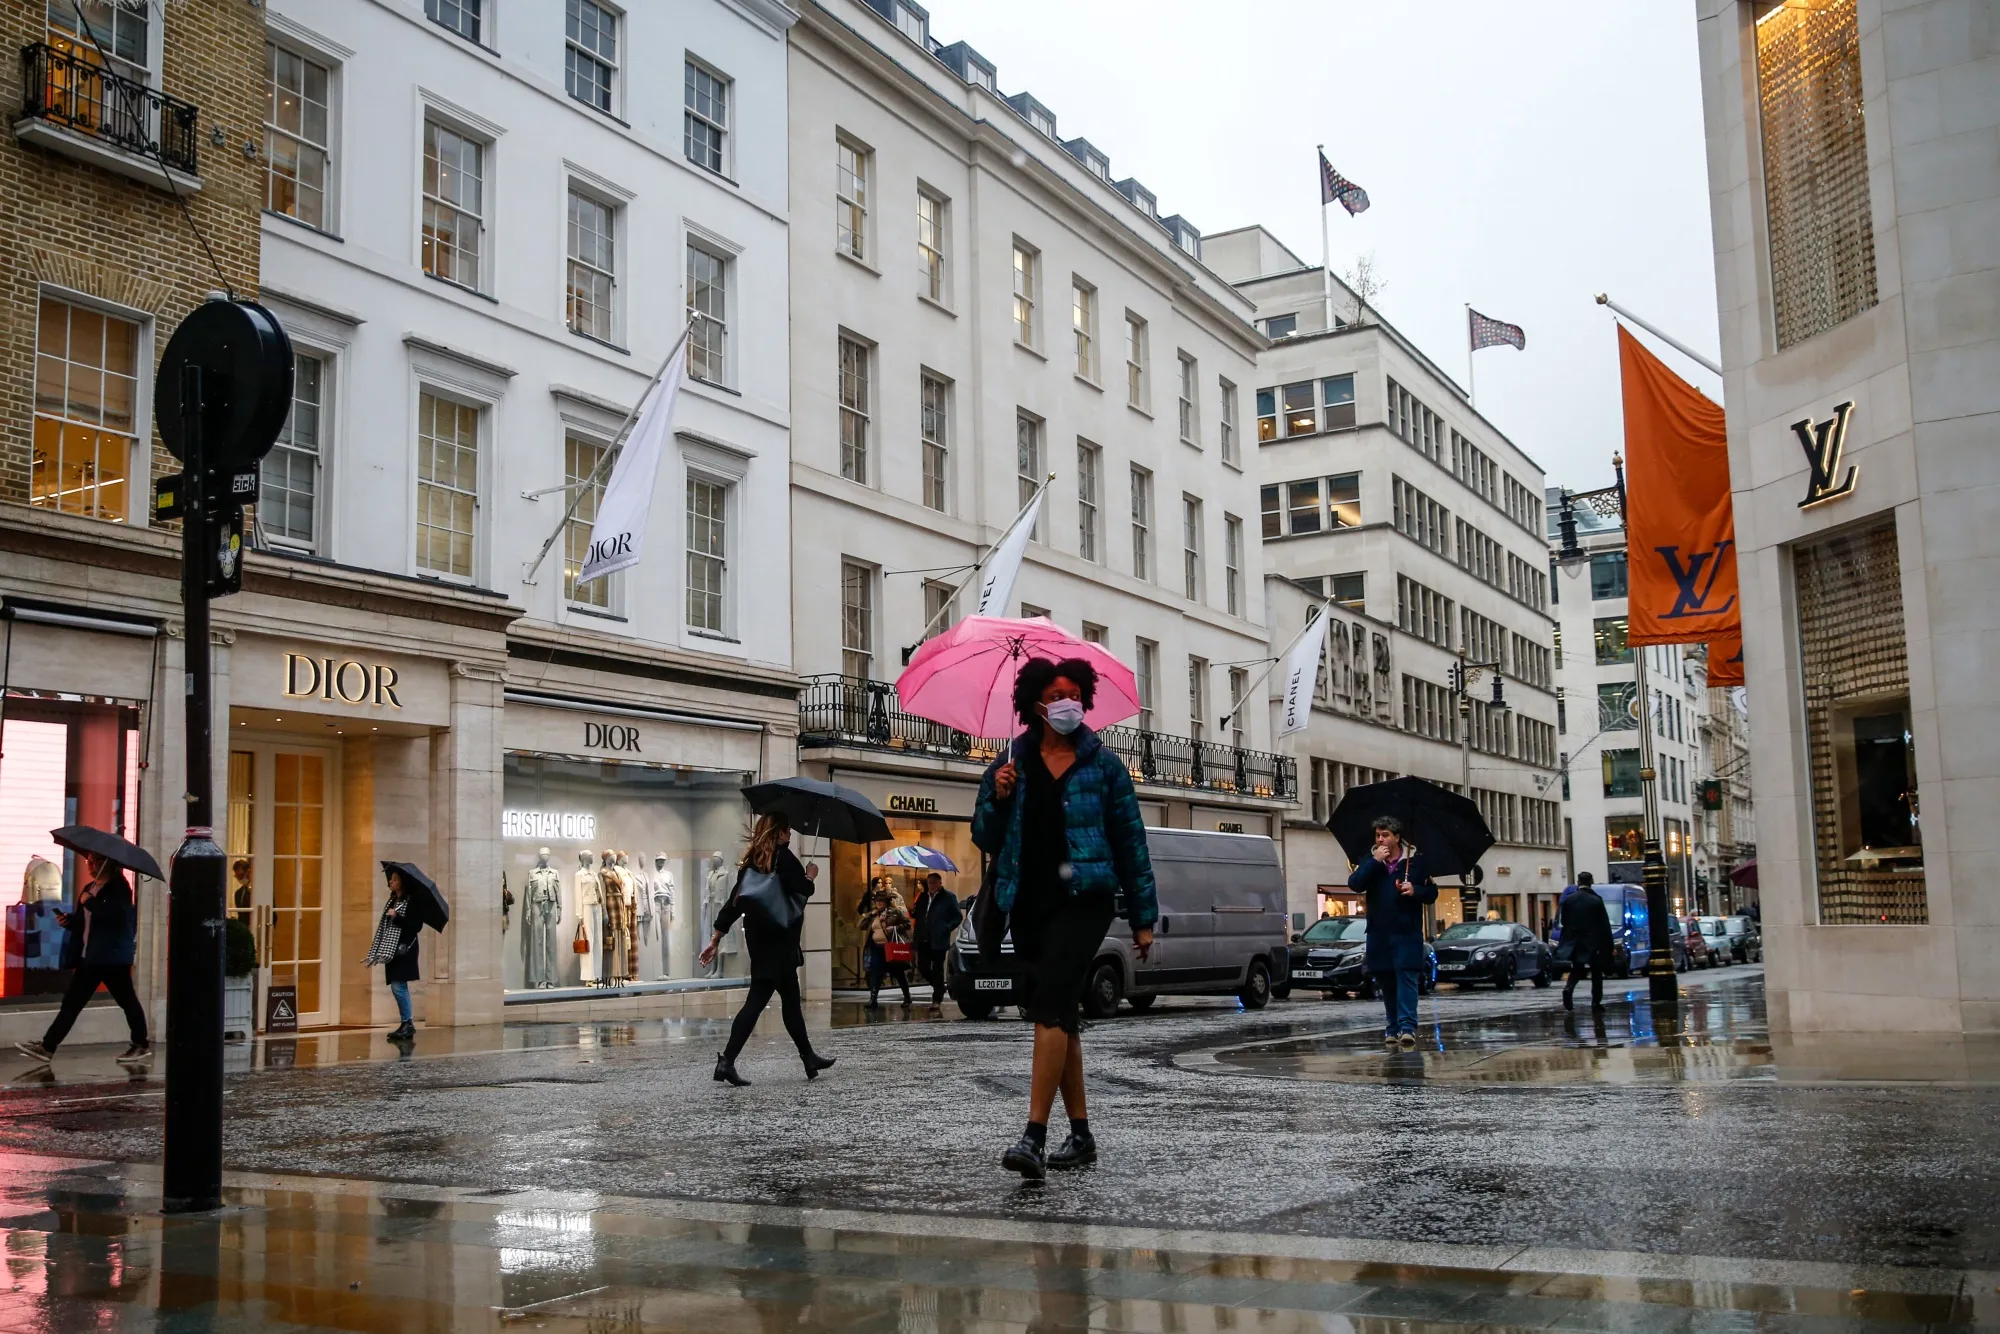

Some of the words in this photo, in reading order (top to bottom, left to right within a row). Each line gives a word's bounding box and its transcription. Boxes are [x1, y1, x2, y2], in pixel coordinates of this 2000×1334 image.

[233, 475, 256, 491] sick
[283, 653, 403, 707] DIOR
[1287, 668, 1301, 726] CHANEL
[584, 722, 642, 752] DIOR
[890, 795, 938, 812] CHANEL
[502, 811, 561, 837] HRISTIAN
[566, 815, 596, 839] DIOR
[1219, 822, 1244, 834] CHANEL
[596, 976, 625, 990] DIOR
[978, 981, 995, 989] LC20
[996, 981, 1010, 989] FUP
